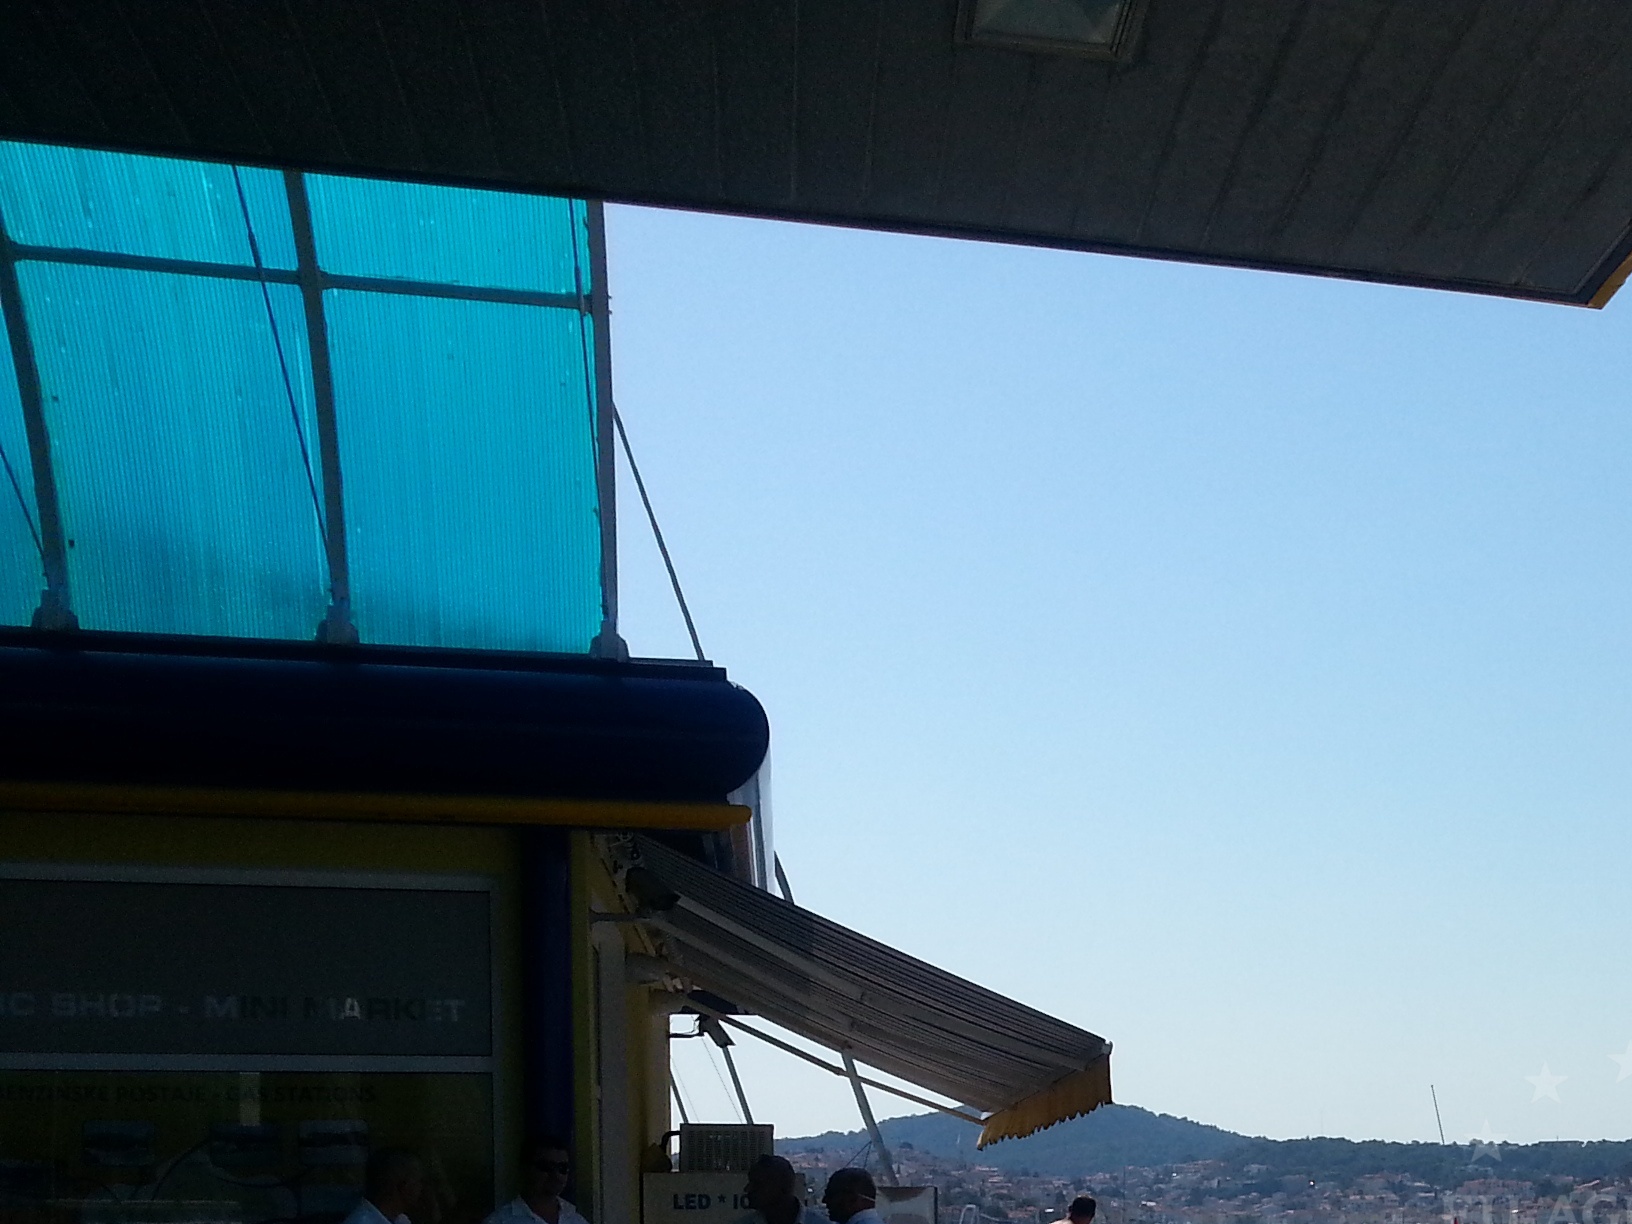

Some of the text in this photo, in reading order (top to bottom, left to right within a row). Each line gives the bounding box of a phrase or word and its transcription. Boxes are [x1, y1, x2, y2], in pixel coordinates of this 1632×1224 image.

[51, 992, 162, 1018] SHOP
[204, 994, 287, 1019] MINI
[304, 997, 465, 1021] MARKET
[225, 1085, 270, 1104] GAS
[274, 1085, 377, 1104] STATIONS
[673, 1194, 711, 1210] LED
